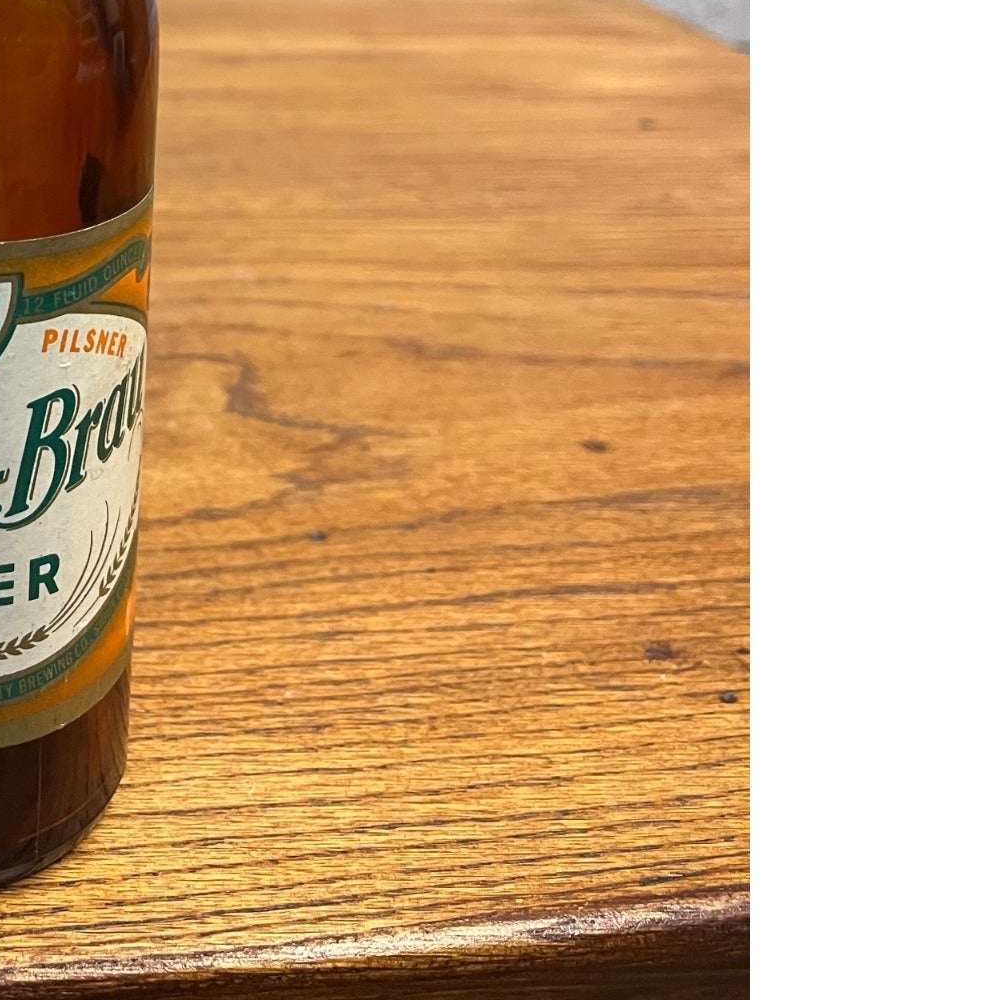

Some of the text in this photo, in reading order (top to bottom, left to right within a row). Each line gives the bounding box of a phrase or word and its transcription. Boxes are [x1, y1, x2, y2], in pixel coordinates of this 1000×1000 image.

[24, 296, 43, 314] 12
[54, 277, 97, 306] FLUID
[41, 328, 128, 358] PILSNER
[18, 656, 73, 696] BREWING
